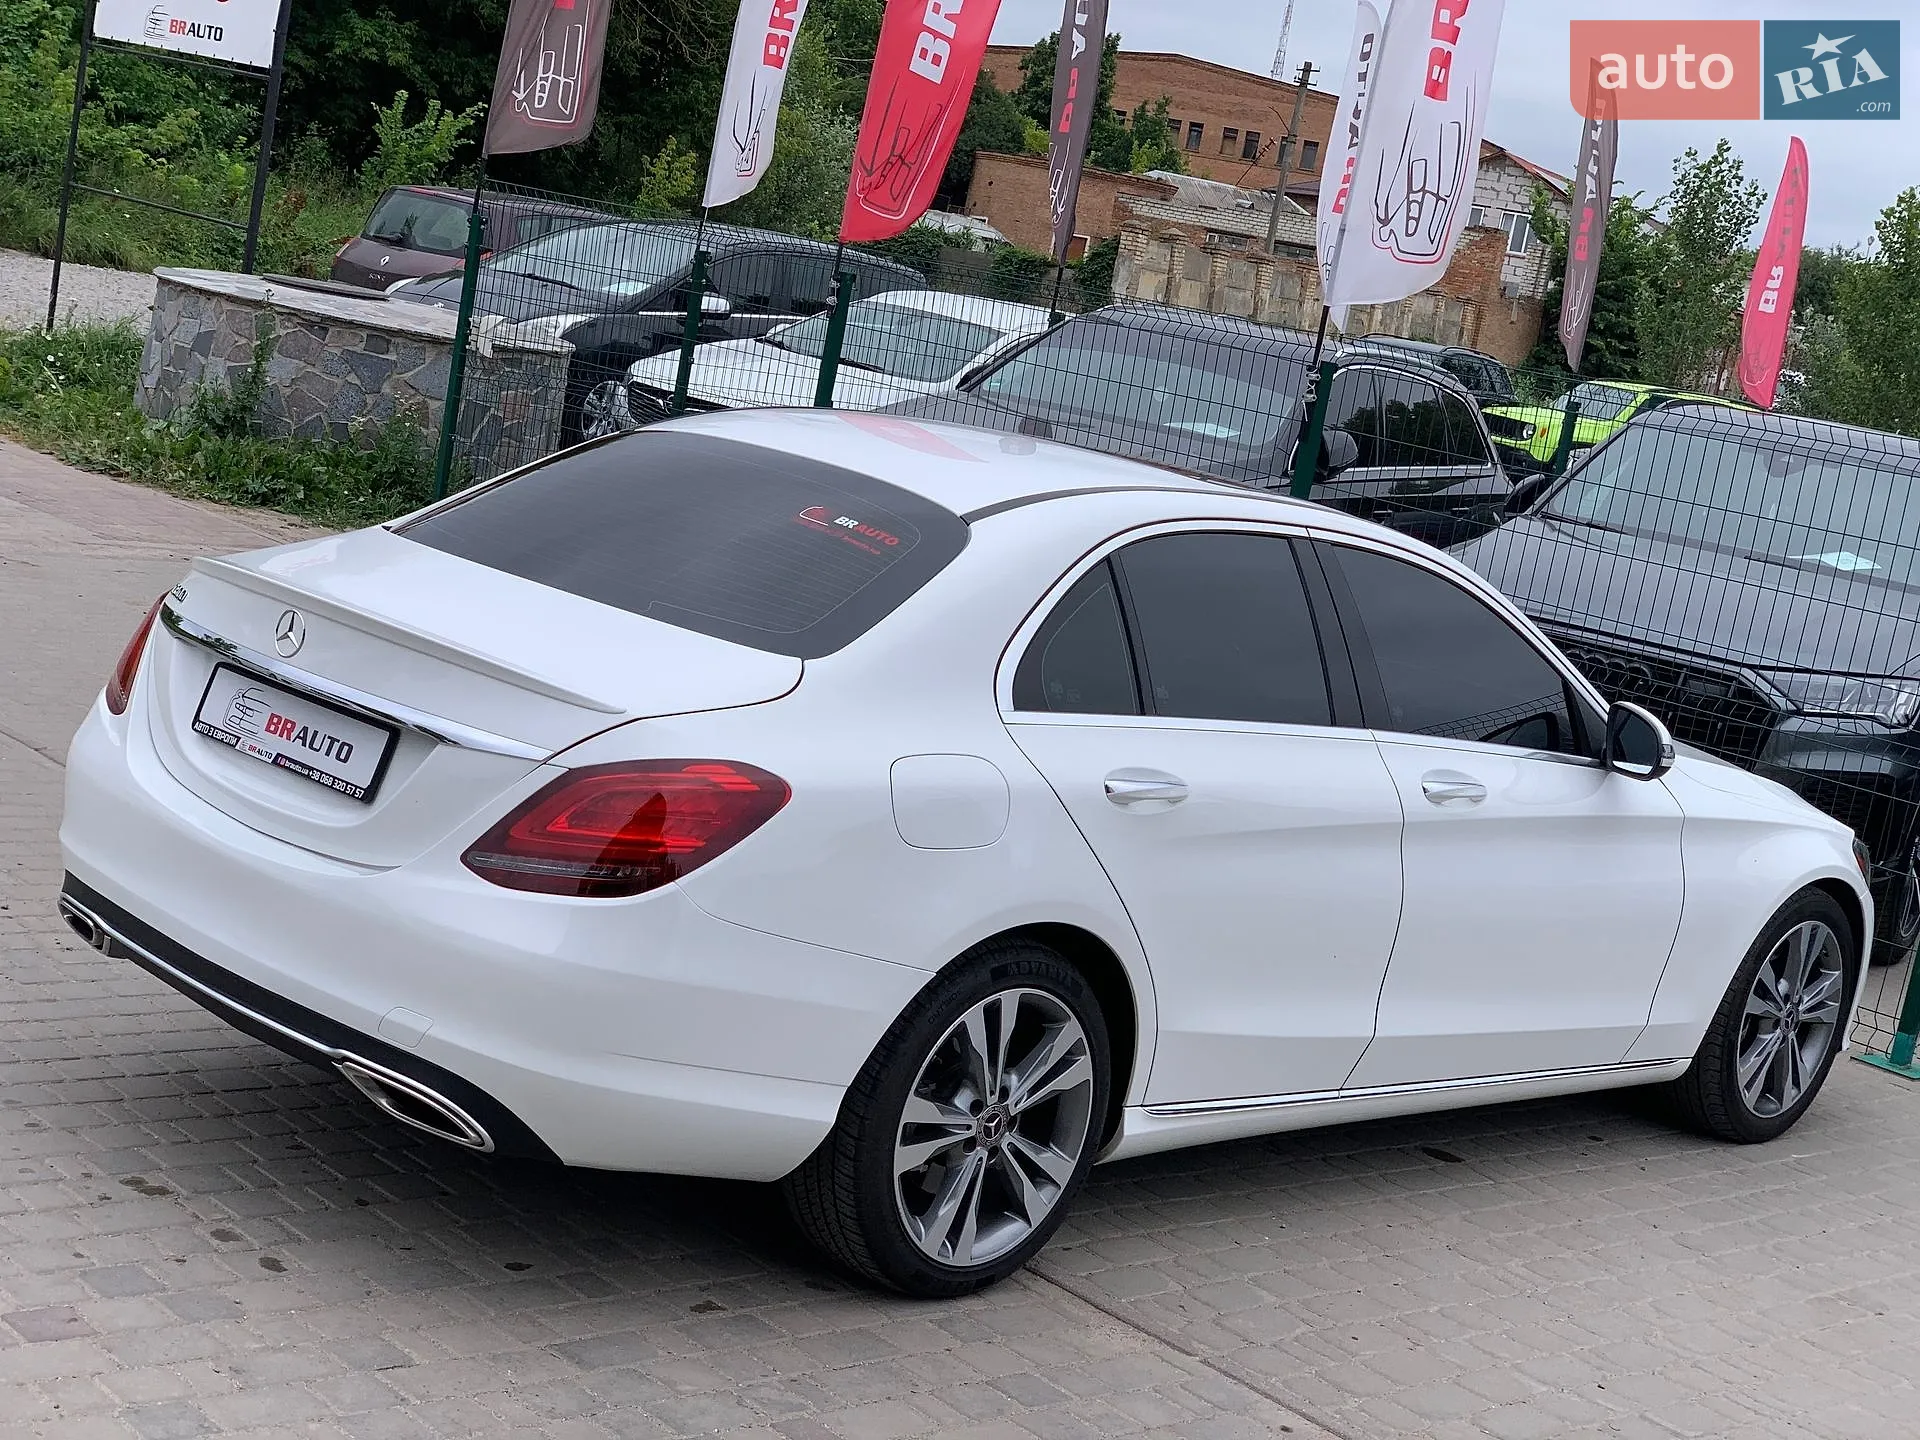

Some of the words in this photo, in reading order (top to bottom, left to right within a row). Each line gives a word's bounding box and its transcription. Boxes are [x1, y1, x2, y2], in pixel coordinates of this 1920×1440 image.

[168, 18, 224, 42] BRAUTO
[833, 516, 900, 546] BRAUTO
[264, 712, 354, 764] BRAUTO
[247, 743, 274, 760] BRAUTO
[319, 773, 334, 786] 068
[332, 777, 347, 792] 320
[345, 786, 356, 795] 57
[354, 789, 365, 799] 57
